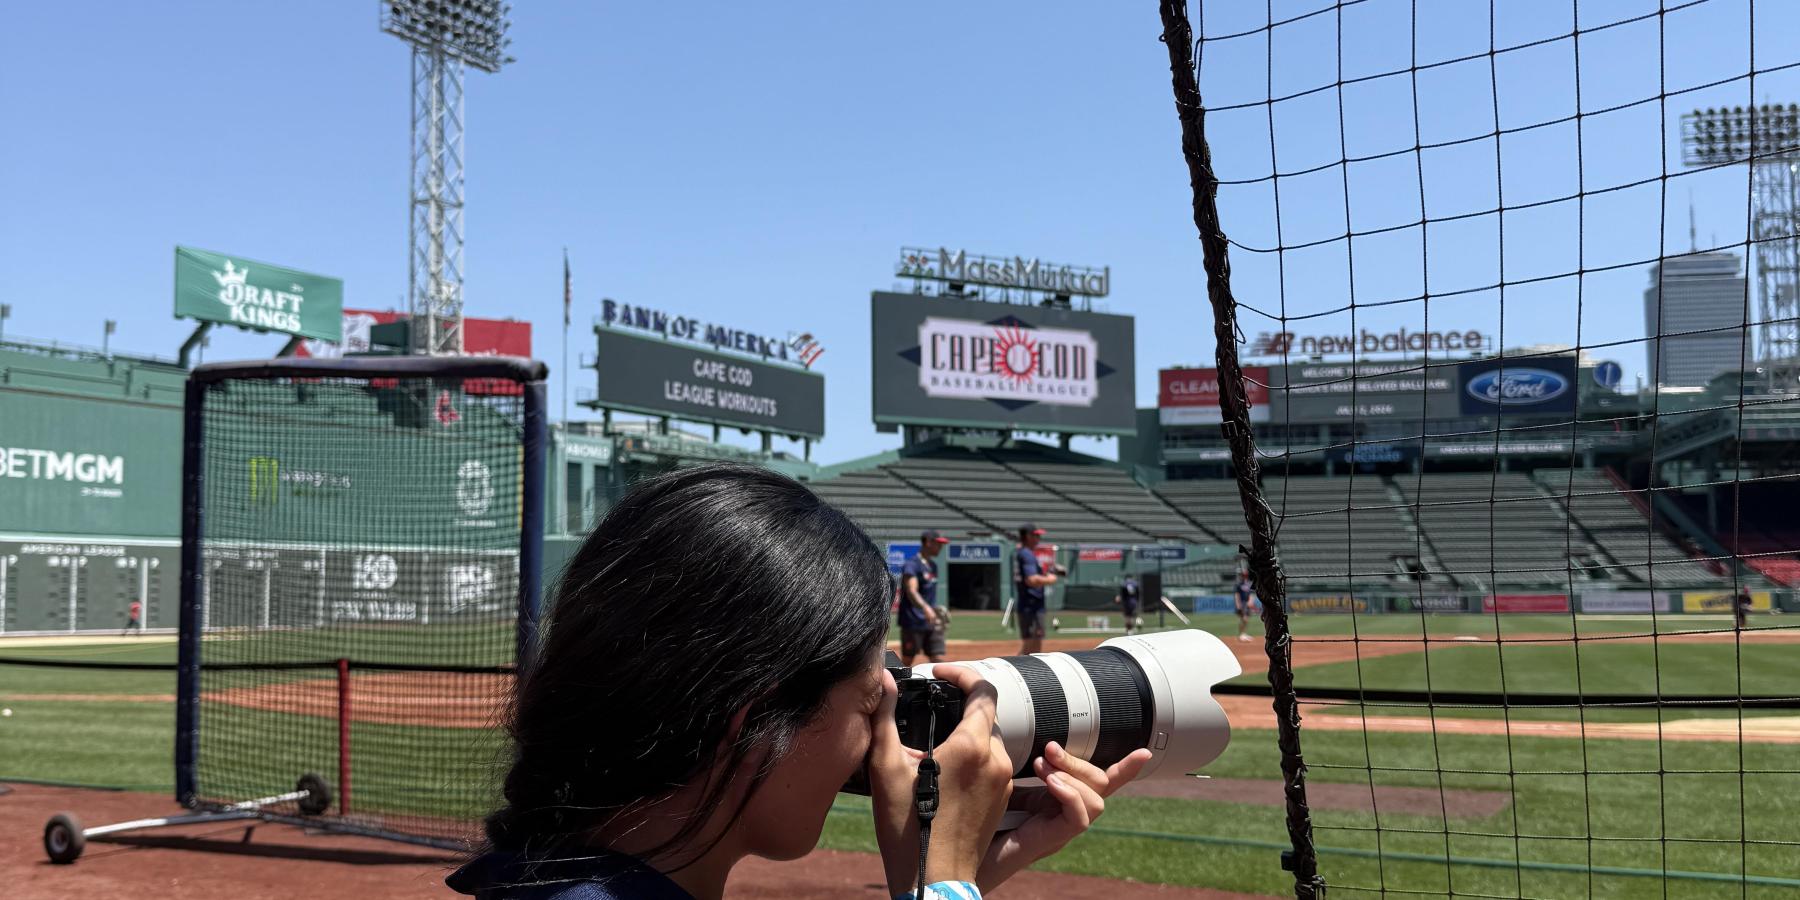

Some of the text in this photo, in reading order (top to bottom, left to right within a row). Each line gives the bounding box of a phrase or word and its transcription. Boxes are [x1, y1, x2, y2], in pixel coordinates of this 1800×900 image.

[939, 247, 1109, 296] MassMutual
[219, 283, 304, 312] DRAFT
[230, 304, 301, 332] KINGS
[602, 299, 788, 360] BANK OF AMERICA
[1301, 327, 1482, 354] new balance
[931, 333, 1086, 380] CAPE COD
[693, 358, 753, 387] CAPE COD
[931, 376, 1088, 396] BASEBALL LEAGUE
[1302, 367, 1344, 378] WELCOME
[1486, 374, 1547, 399] Ford
[664, 380, 777, 417] LEAGUE WORKOUTS
[20, 543, 80, 555] AMERICAN
